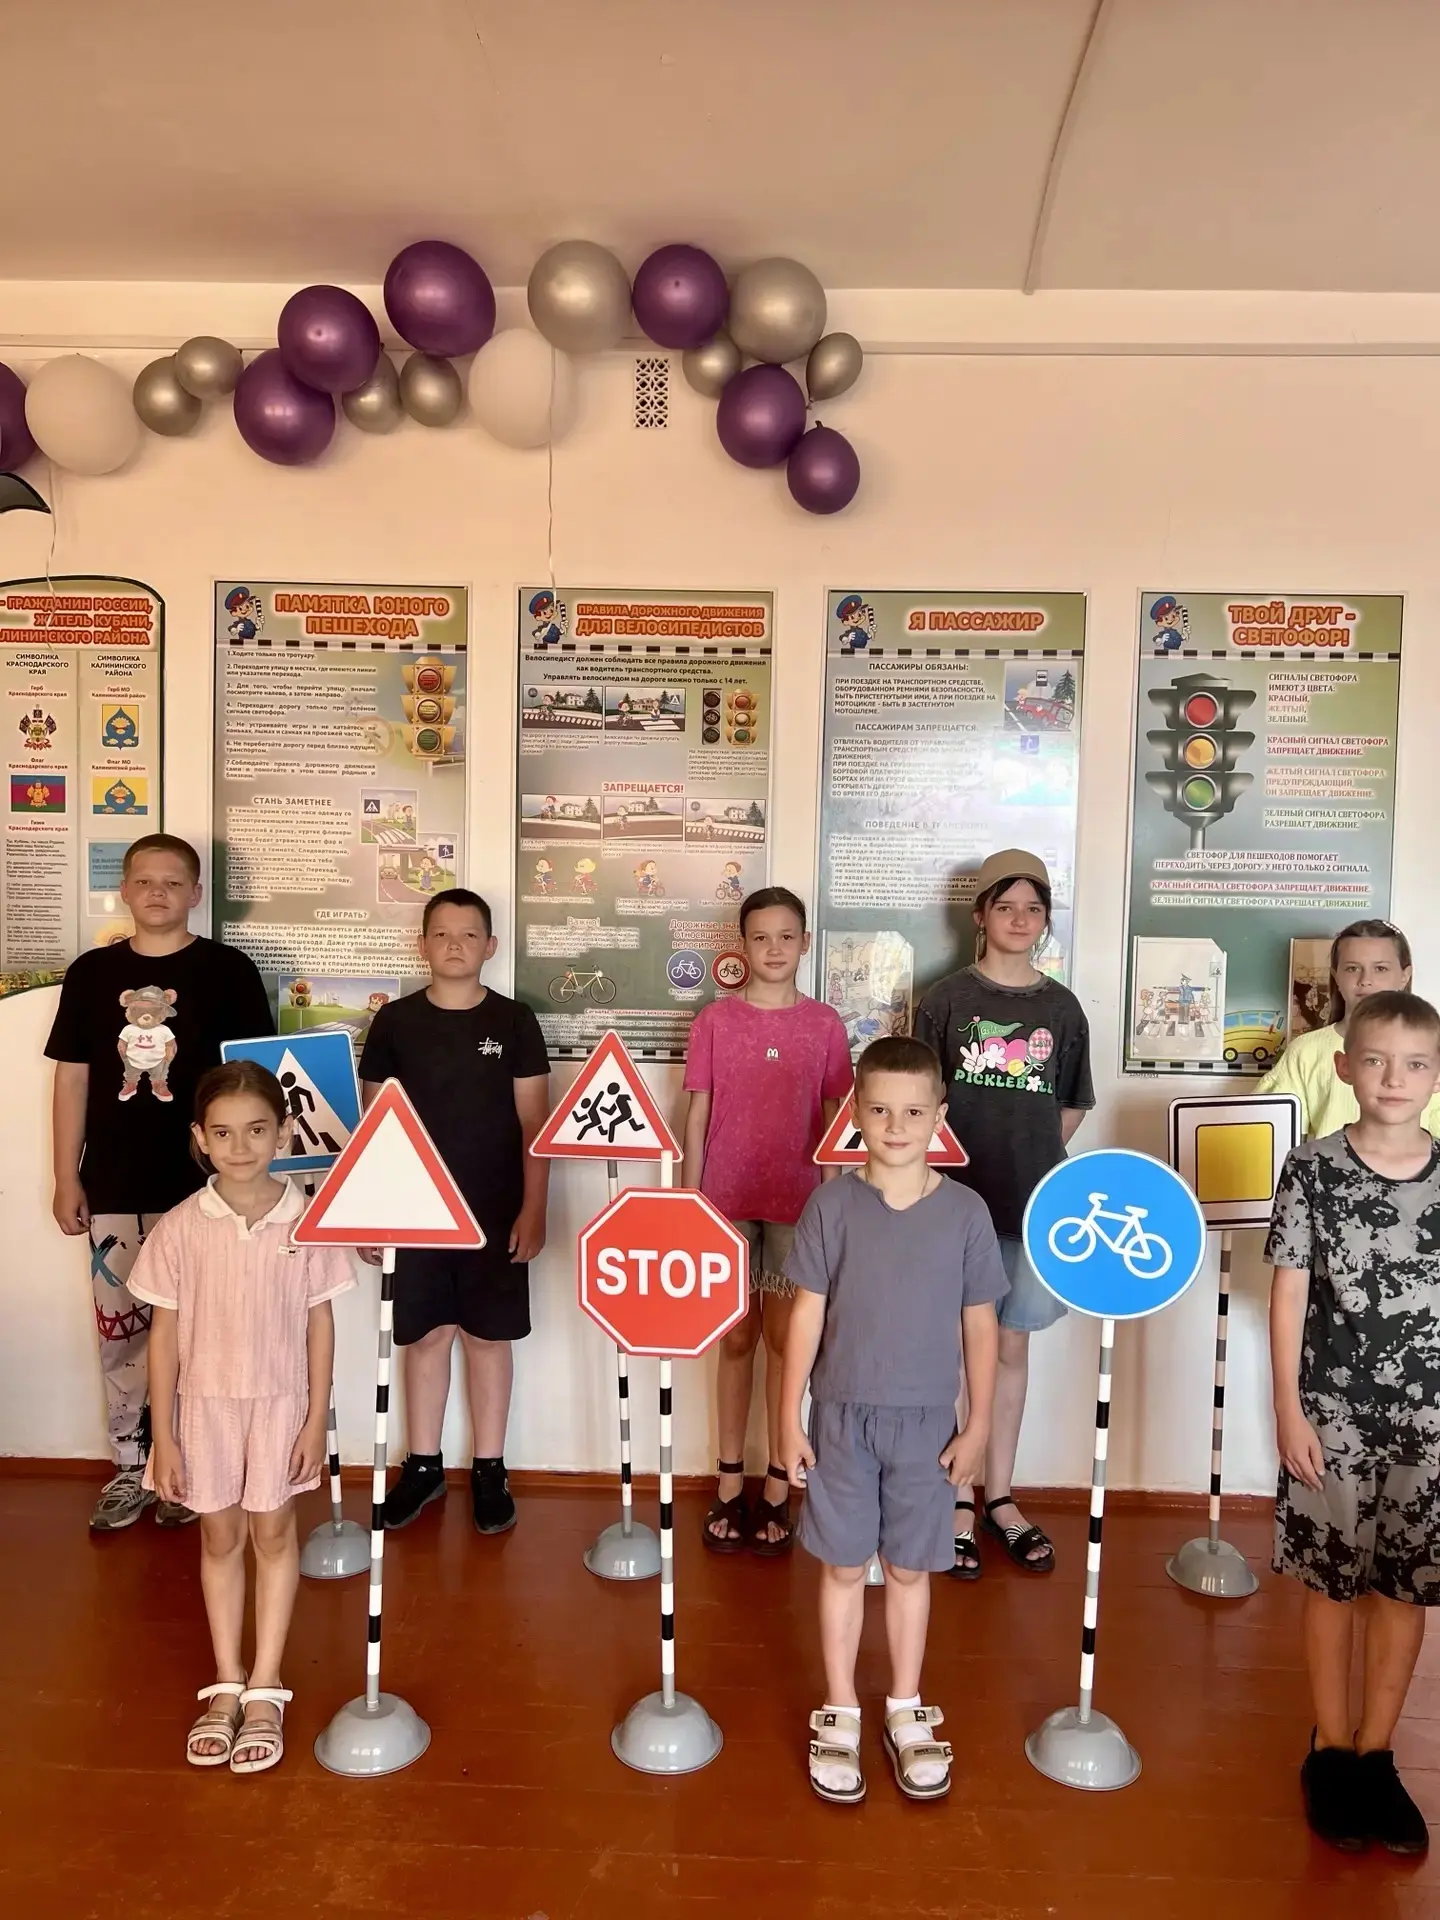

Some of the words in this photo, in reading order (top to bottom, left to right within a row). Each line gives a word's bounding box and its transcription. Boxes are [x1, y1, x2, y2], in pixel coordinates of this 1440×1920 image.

[8, 597, 91, 612] ГРАЖДАНИН
[94, 598, 153, 613] РОССИИ,
[275, 594, 370, 615] ПАМЯТКА
[374, 596, 449, 616] ЮНОГО
[577, 604, 629, 616] ПРАВИЛА
[631, 605, 700, 618] ДОРОЖНОГО
[701, 606, 764, 619] ДВИЖЕНИЯ
[34, 614, 92, 627] ЖИТЕЛЬ
[94, 615, 153, 629] КУБАНИ,
[909, 612, 924, 630] Я
[929, 611, 1044, 631] ПАССАЖИР
[1228, 602, 1285, 624] ТВОЙ
[1288, 606, 1343, 628] ДРУГ
[306, 616, 418, 638] ПЕШЕХОДА
[576, 619, 613, 636] ДЛЯ
[615, 619, 764, 638] ВЕЛОСИПЕДИСТОВ
[93, 628, 150, 644] РАЙОНА
[1233, 627, 1349, 646] СВЕТОФОР!
[525, 654, 574, 663] Велосипедист
[605, 657, 642, 666] соблюдать
[658, 658, 687, 666] правила
[689, 659, 729, 667] дорожного
[543, 674, 580, 682] Управлять
[582, 675, 630, 683] велосипедом
[642, 676, 666, 684] дороге
[1269, 673, 1308, 682] СИГНАЛЫ
[1310, 674, 1357, 682] СВЕТОФОРА
[1267, 736, 1306, 745] КРАСНЫЙ
[1308, 737, 1339, 745] СИГНАЛ
[1342, 738, 1388, 746] СВЕТОФОРА
[1267, 747, 1314, 755] ЗАПРЕЩАЕТ
[603, 783, 684, 794] ЗАПРЕЩАЕТСЯ!
[254, 797, 282, 805] СТАНЬ
[286, 798, 332, 807] ЗАМЕТНЕЕ
[1265, 809, 1303, 818] ЗЕЛЕНЫЙ
[1305, 810, 1336, 818] СИГНАЛ
[1338, 810, 1385, 819] СВЕТОФОРА
[1186, 852, 1227, 860] СВЕТОФОР
[1229, 853, 1245, 861] ДЛЯ
[1247, 853, 1294, 861] ПЕШЕХОДОВ
[1296, 853, 1338, 862] ПОМОГАЕТ
[1156, 862, 1206, 870] ПЕРЕХОДИТЬ
[1152, 881, 1191, 890] КРАСНЫЙ
[1226, 883, 1273, 891] СВЕТОФОРА
[1275, 883, 1322, 892] ЗАПРЕЩАЕТ
[1153, 896, 1191, 904] ЗЕЛЕНЫЙ
[1226, 898, 1273, 906] СВЕТОФОРА
[1275, 899, 1322, 907] РАЗРЕШАЕТ
[316, 911, 331, 919] ГДЕ
[333, 911, 367, 919] ИГРАТЬ?
[955, 1069, 1053, 1094] PICKLEBLL
[596, 1247, 731, 1298] STOP
